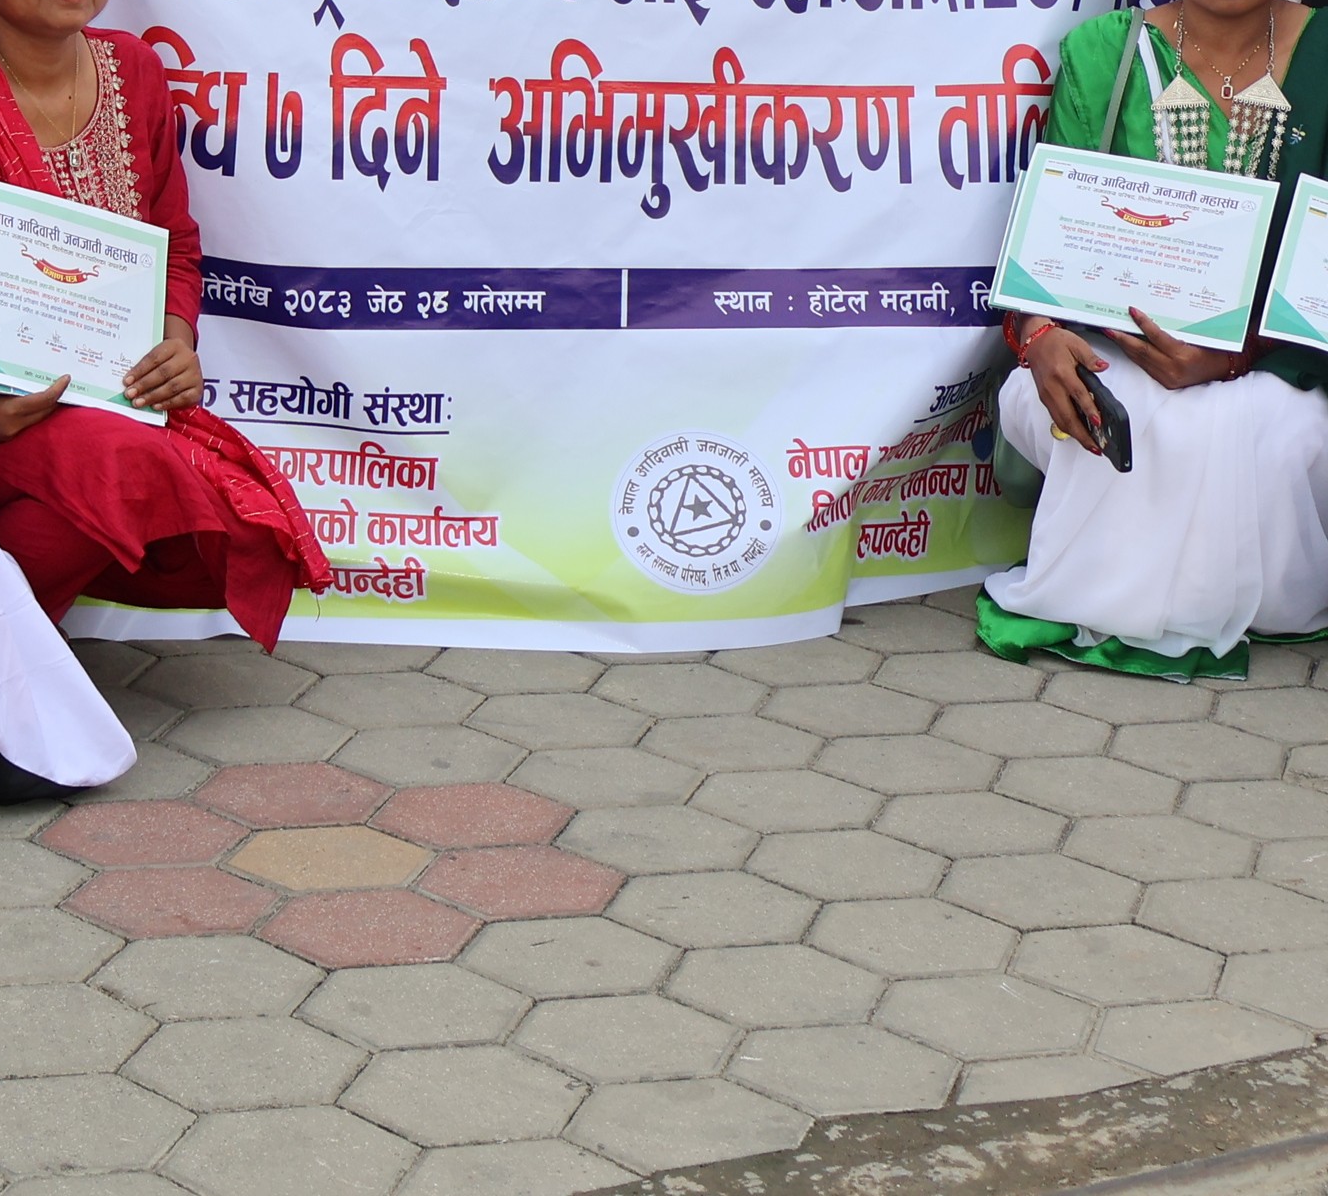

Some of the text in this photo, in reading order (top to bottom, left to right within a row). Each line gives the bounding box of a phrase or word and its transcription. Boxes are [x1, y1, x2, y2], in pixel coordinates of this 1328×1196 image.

[152, 26, 247, 177] न्धि
[265, 73, 304, 181] ७
[329, 33, 447, 192] दिने
[487, 39, 914, 220] अभिमुखीकरण
[1067, 167, 1099, 185] नेपाल
[1100, 175, 1150, 194] आदिवासी
[1199, 194, 1240, 210] महासंघ
[17, 218, 61, 242] आदिवासी
[104, 244, 139, 265] महासंघ
[201, 275, 272, 308] तेदेखि
[284, 288, 351, 317] २०८३
[367, 284, 406, 314] जेठ
[463, 284, 546, 314] गतेसम्म
[714, 290, 772, 315] स्थान
[808, 284, 868, 318] होटेल
[879, 282, 956, 315] मदानी,
[229, 377, 353, 419] सहयोगी
[363, 386, 453, 425] संस्था:
[618, 436, 774, 515] नेपाल आदिवासी जनजाती महासंघ
[787, 438, 871, 480] नेपाल
[900, 464, 968, 503] समन्वय
[368, 506, 499, 547] कार्यालय
[314, 557, 427, 597] पन्देही
